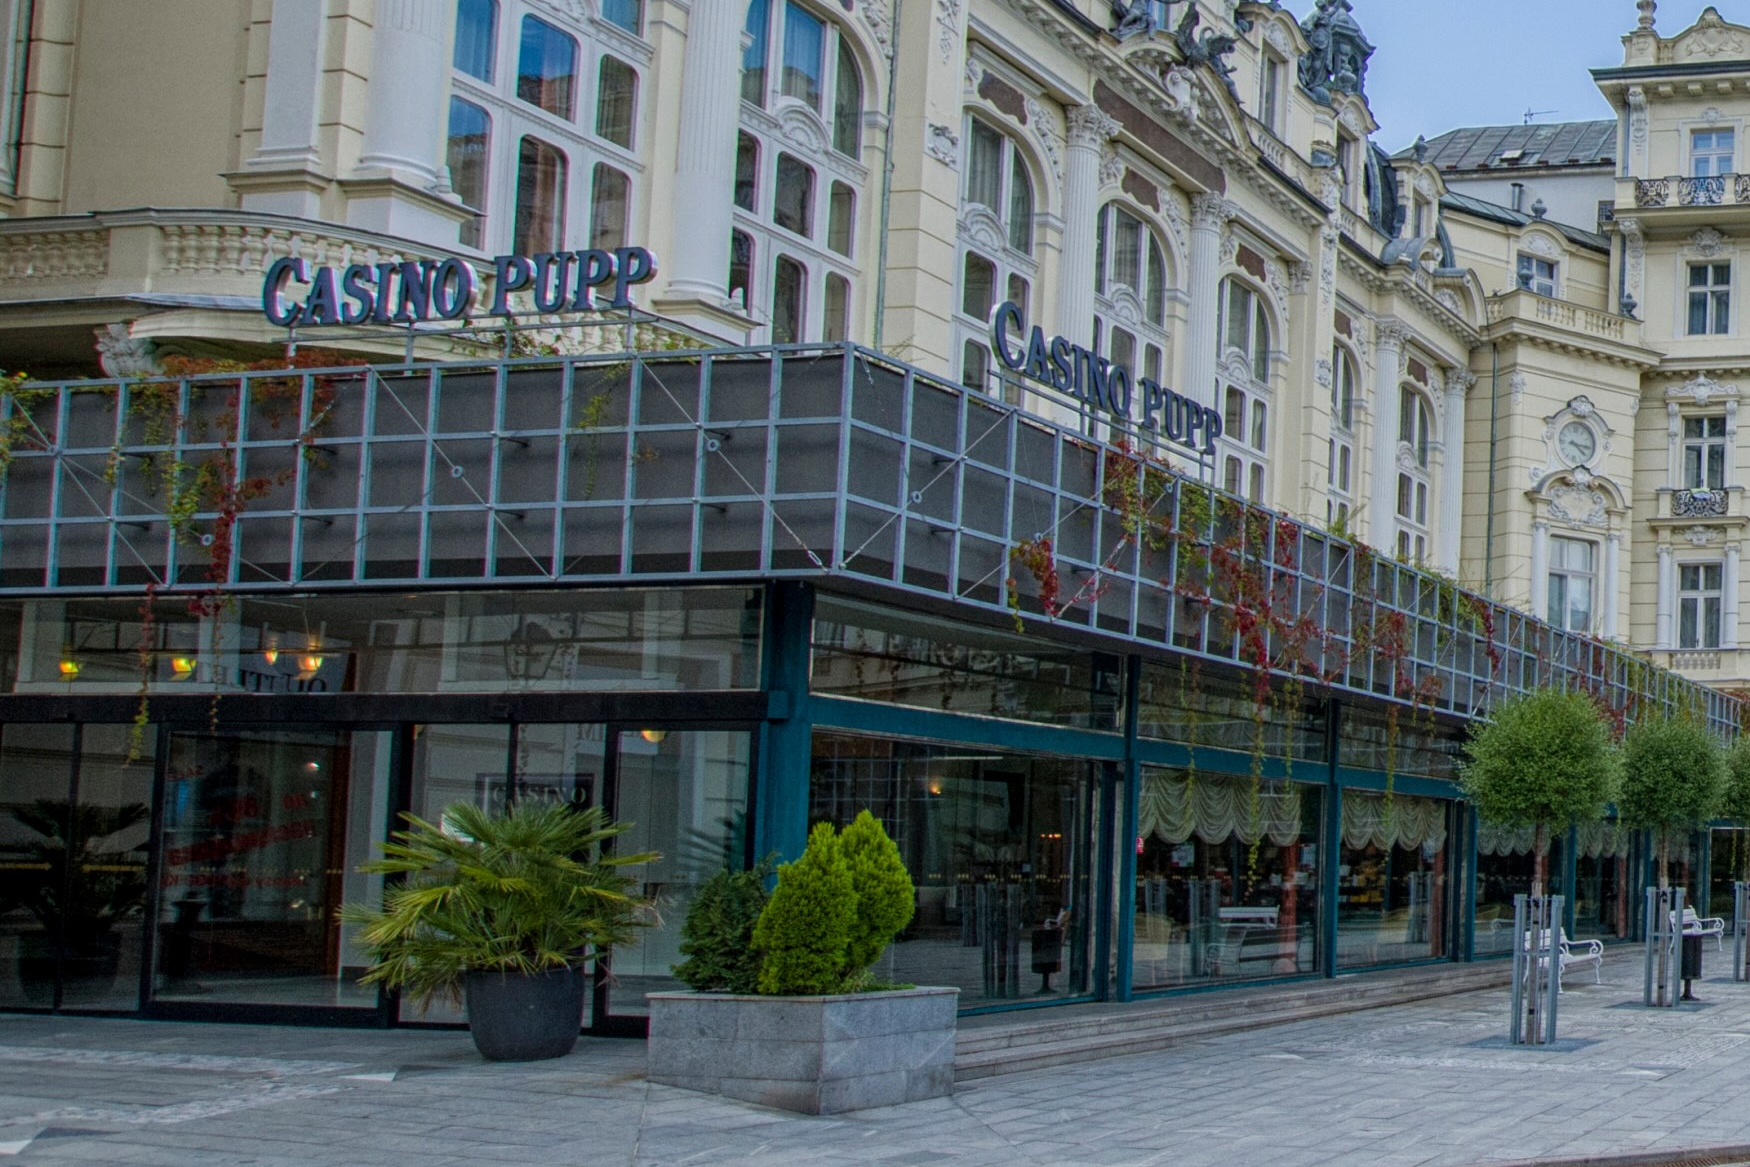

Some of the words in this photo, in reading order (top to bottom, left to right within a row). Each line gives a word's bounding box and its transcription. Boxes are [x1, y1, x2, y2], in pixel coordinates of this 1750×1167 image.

[261, 255, 479, 328] CASINO
[490, 246, 659, 316] PUPP
[989, 300, 1132, 418] CASINO
[1137, 377, 1223, 456] PUPP
